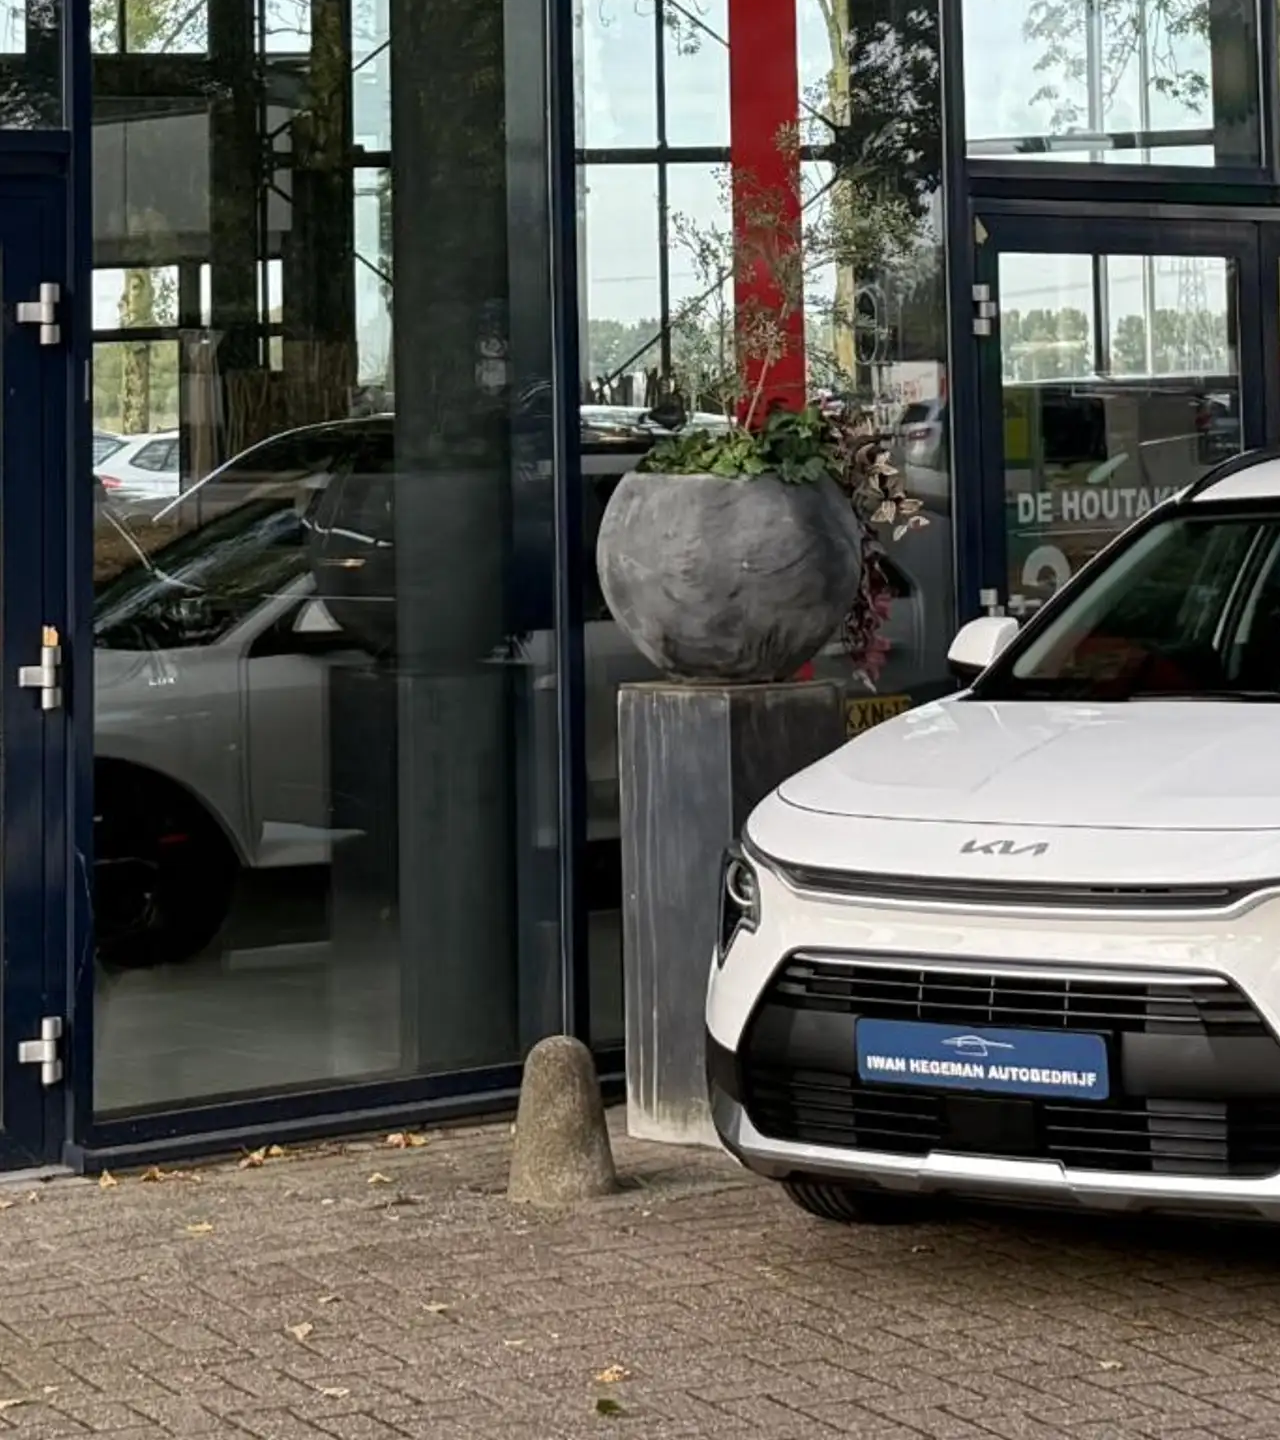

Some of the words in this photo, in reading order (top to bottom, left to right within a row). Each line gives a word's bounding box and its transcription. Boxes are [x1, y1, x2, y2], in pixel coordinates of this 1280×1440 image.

[1017, 491, 1053, 524] DE
[959, 838, 1050, 857] KIA
[866, 1055, 906, 1073] IWAN
[910, 1059, 985, 1080] HEGEMAN
[988, 1066, 1097, 1088] AUTOBEDRIJF
